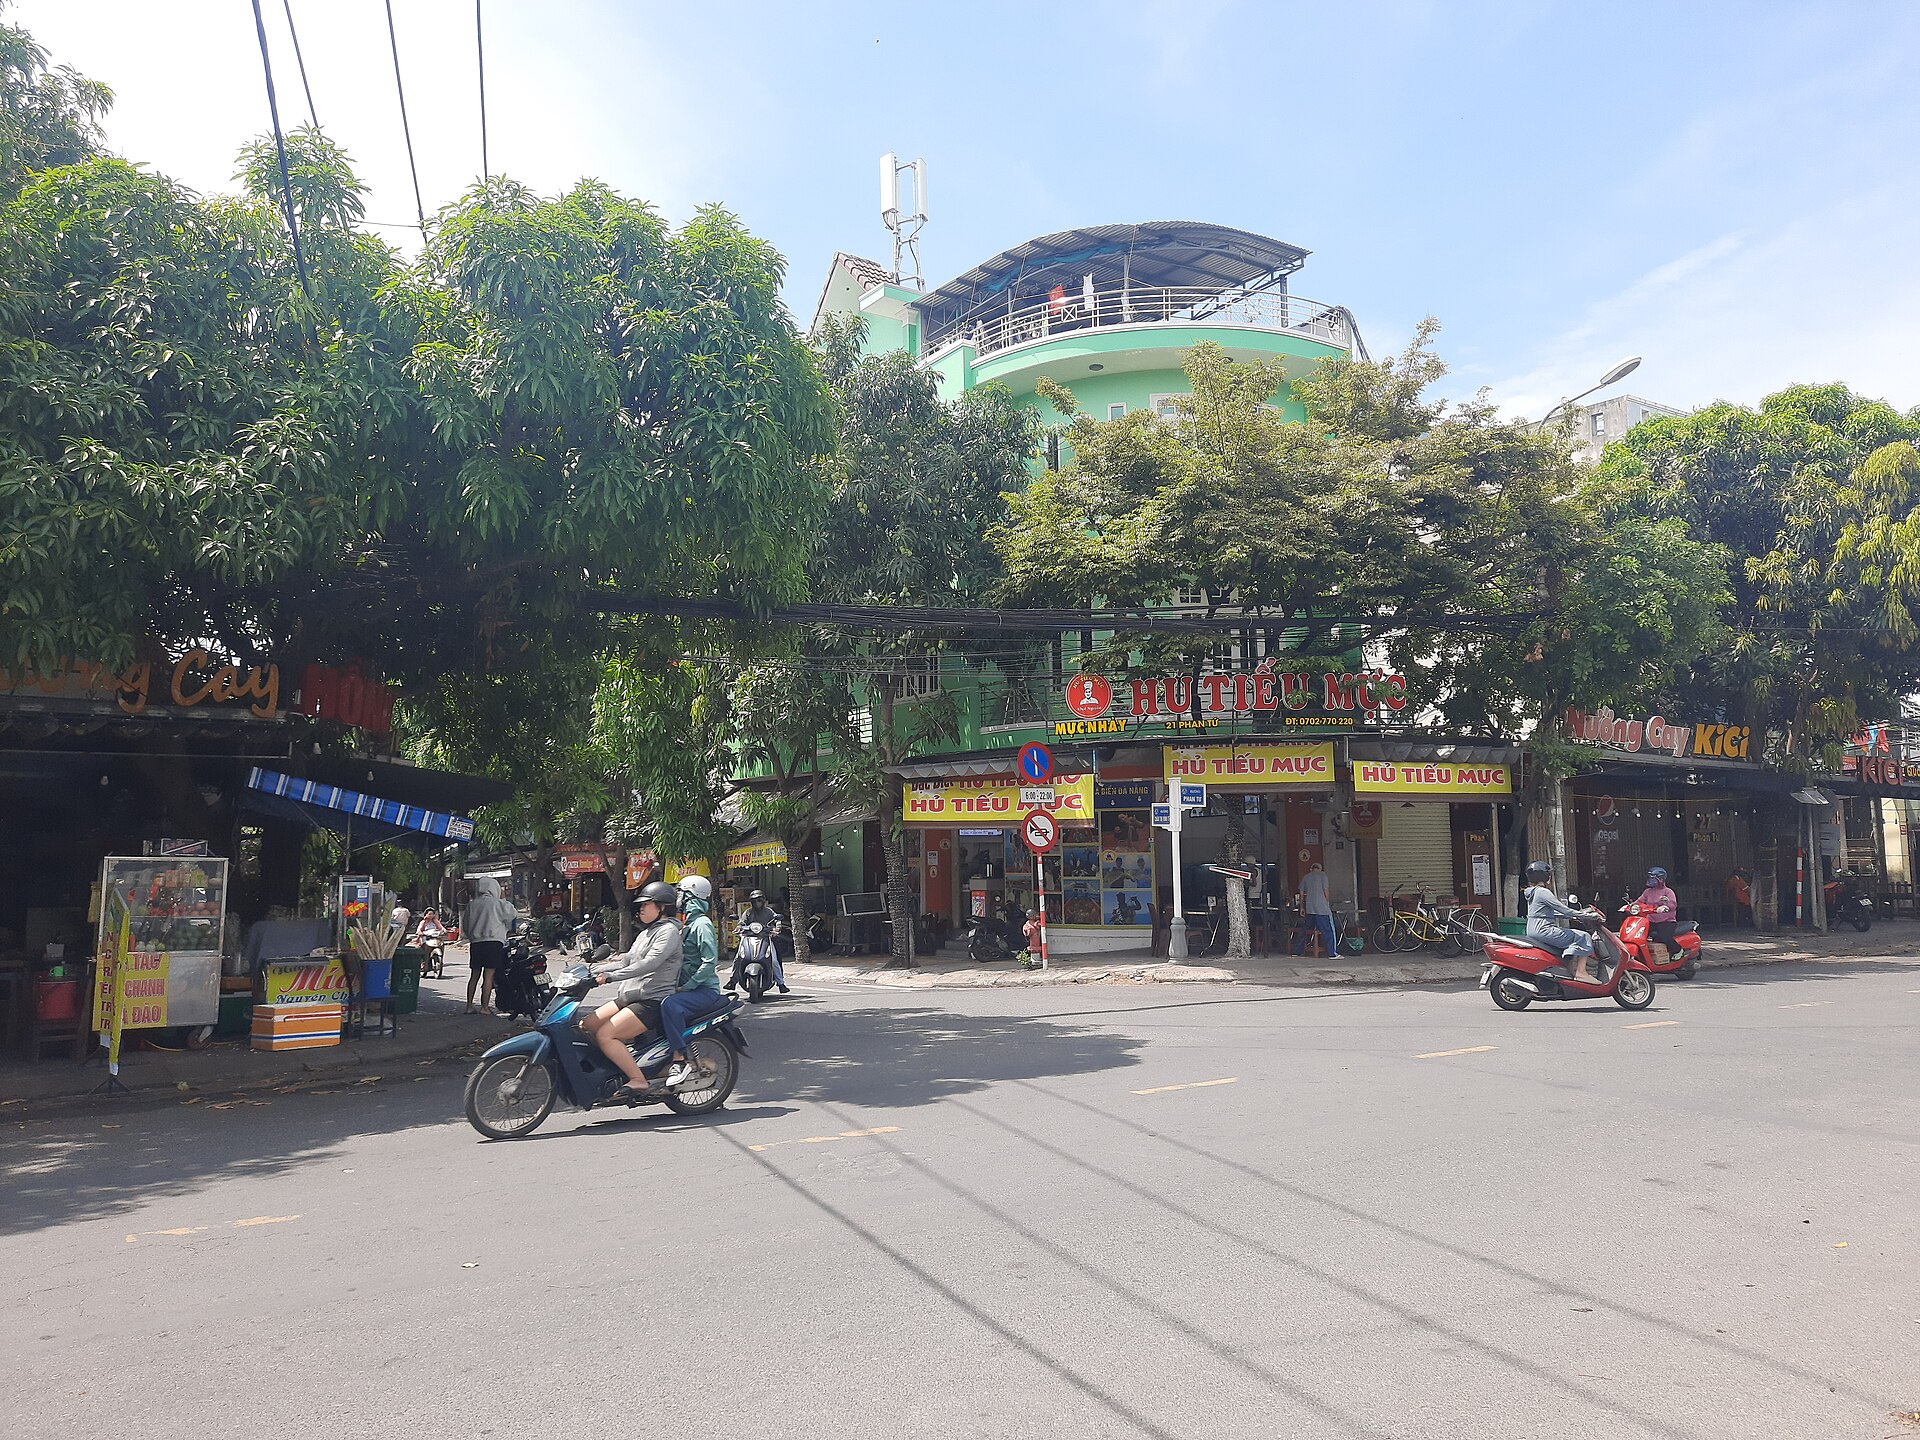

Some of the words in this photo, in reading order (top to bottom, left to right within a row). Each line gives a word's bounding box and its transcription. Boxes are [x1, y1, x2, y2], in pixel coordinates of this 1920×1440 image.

[170, 648, 280, 718] Cay
[1203, 656, 1311, 712] TIẾU
[1166, 721, 1176, 729] 21
[1179, 720, 1205, 729] PHAN
[1285, 717, 1298, 725] ĐT:
[1646, 716, 1691, 758] Cay
[1172, 755, 1207, 775] HỦ
[1211, 752, 1265, 774] TIẾU
[1271, 756, 1326, 775] MỰC
[1362, 762, 1396, 782] HỦ
[1401, 763, 1451, 783] TIẾU
[1457, 769, 1505, 787] MỰC
[910, 794, 945, 812] HỦ
[951, 792, 1009, 812] TIẾU
[124, 978, 165, 998] CHANH
